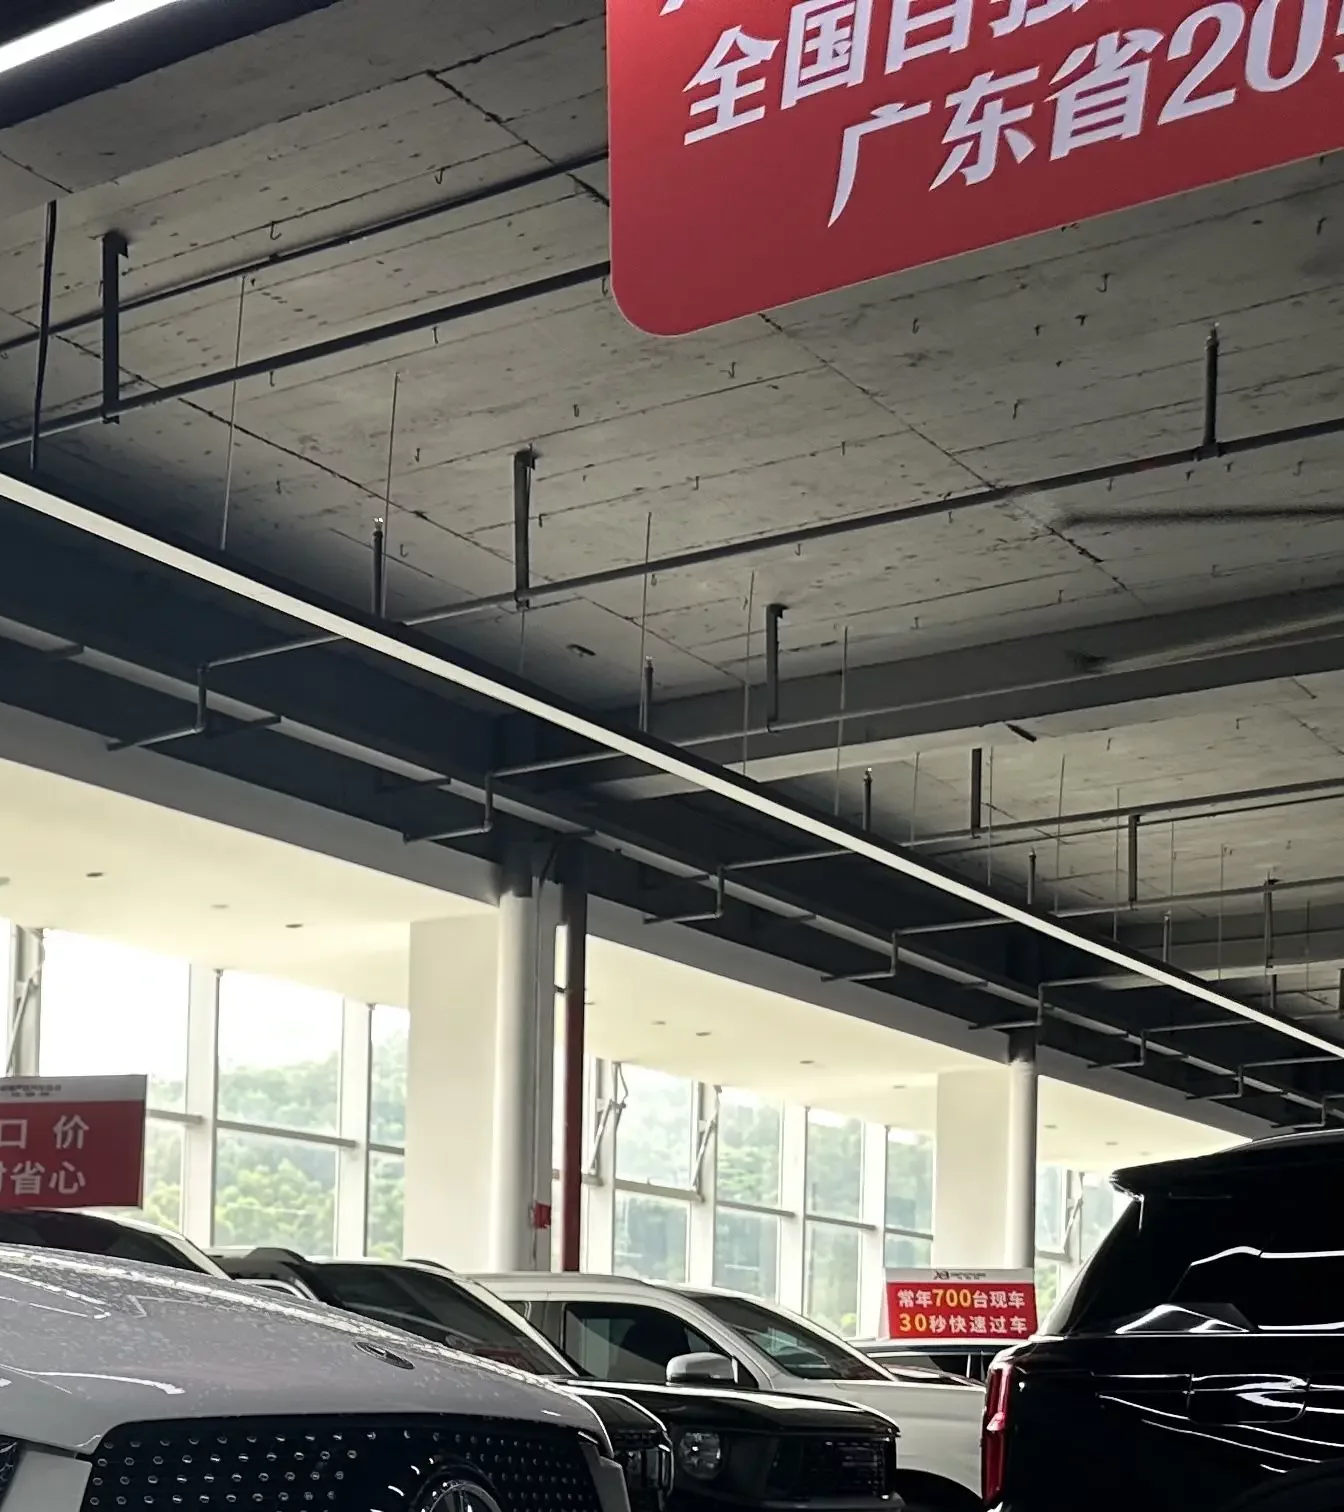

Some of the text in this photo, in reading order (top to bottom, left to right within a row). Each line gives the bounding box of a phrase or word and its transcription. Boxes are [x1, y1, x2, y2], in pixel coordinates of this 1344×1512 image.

[828, 0, 1344, 226] 广东省20
[897, 1288, 1025, 1309] 常年700台现车
[899, 1312, 1028, 1334] 30秒快速过车
